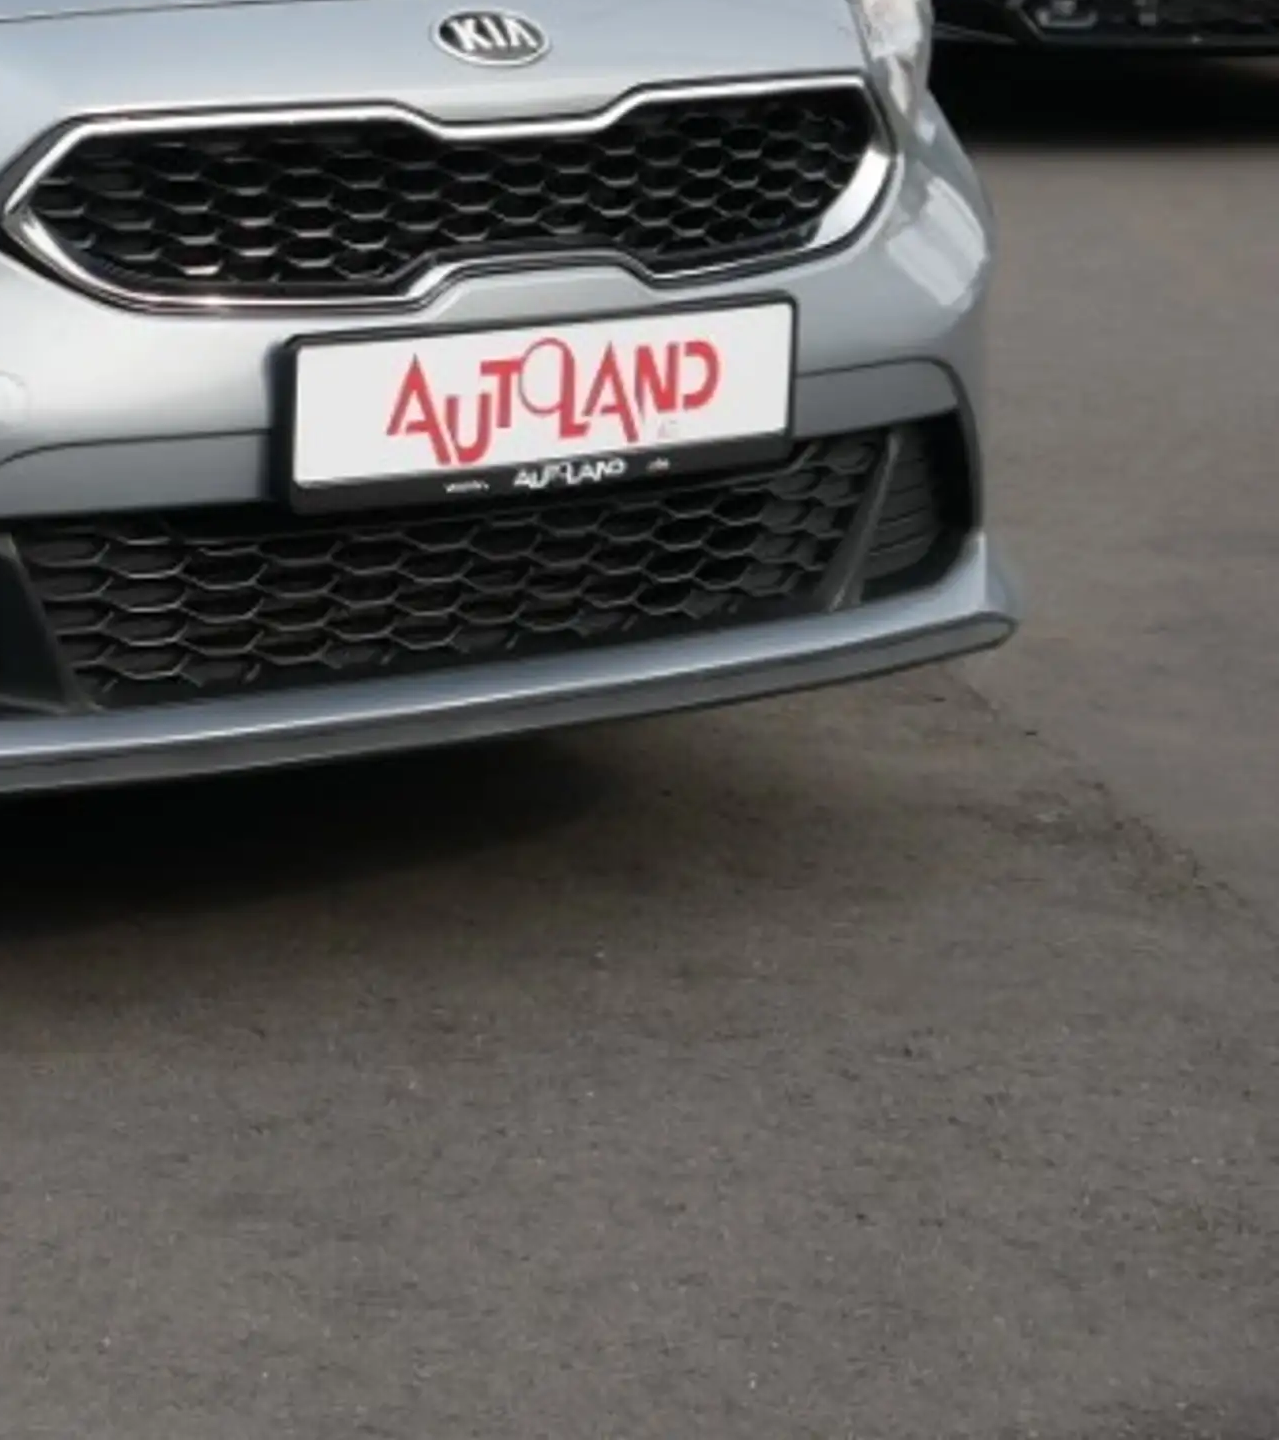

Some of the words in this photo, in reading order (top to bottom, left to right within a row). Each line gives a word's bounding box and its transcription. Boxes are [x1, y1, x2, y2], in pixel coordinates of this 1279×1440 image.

[450, 14, 539, 52] KIA
[386, 337, 720, 466] AUTOLAND
[513, 458, 628, 489] AUTOLAND
